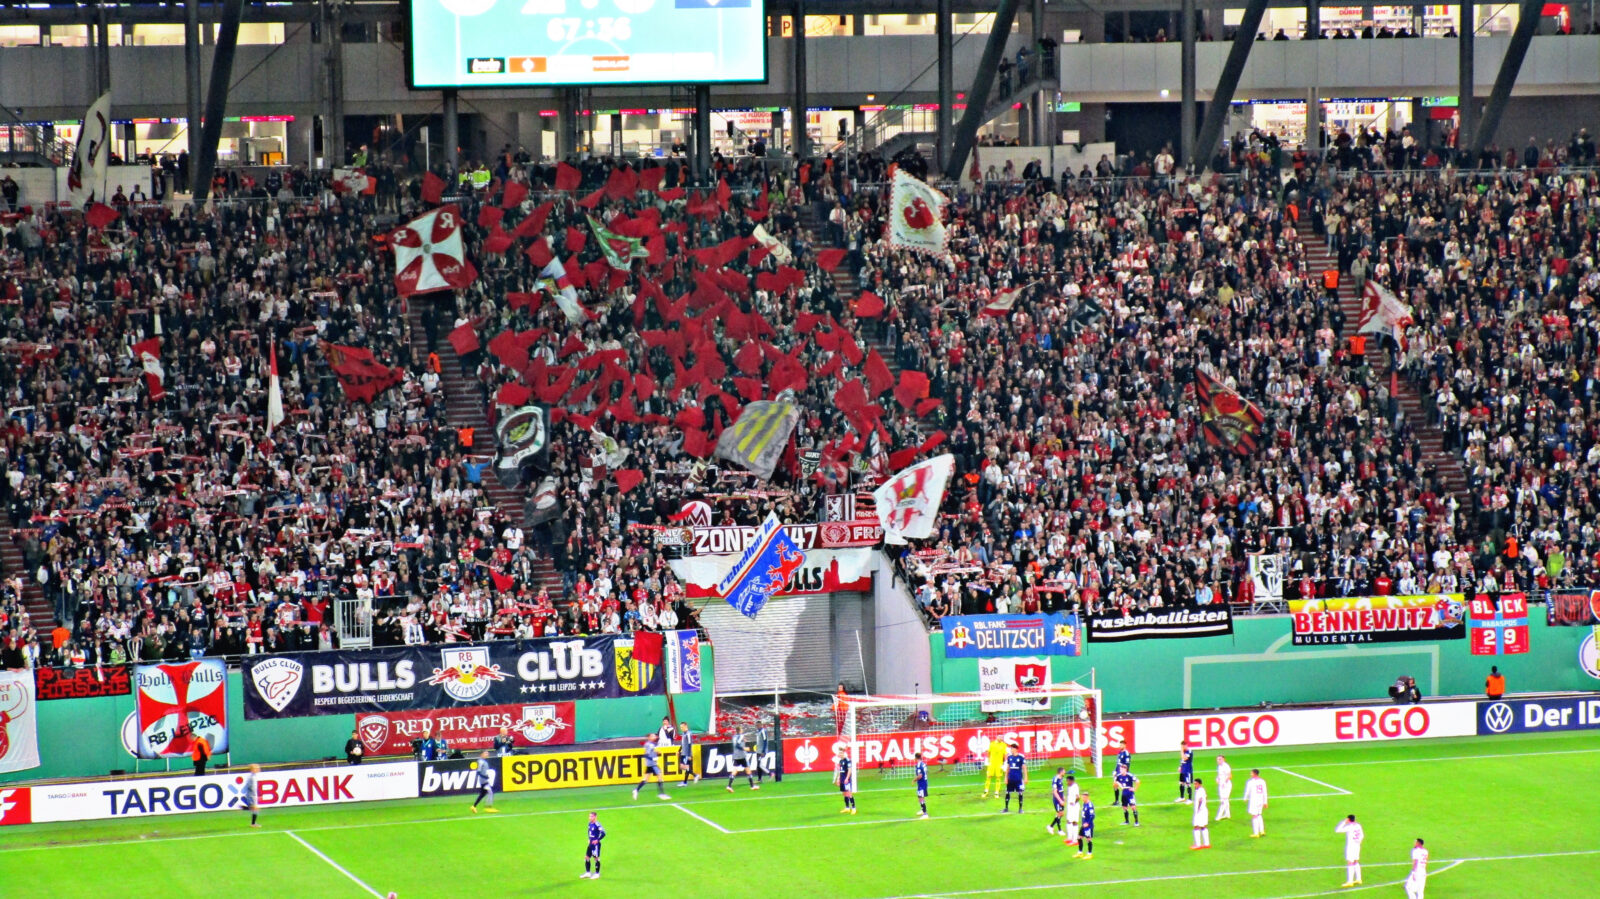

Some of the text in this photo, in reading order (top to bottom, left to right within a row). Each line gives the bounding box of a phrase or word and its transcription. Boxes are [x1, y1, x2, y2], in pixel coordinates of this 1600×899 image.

[973, 620, 1007, 630] RBL FANS
[1092, 609, 1228, 628] rasenballisten
[1293, 607, 1434, 634] BENNEWITZ
[976, 627, 1045, 649] DELITZSCH
[1295, 633, 1374, 644] MULDENTAL
[458, 652, 473, 661] RB
[517, 640, 604, 682] CLUB
[253, 660, 301, 675] BULLS CLUB
[311, 660, 416, 694] BULLS
[38, 681, 130, 698] HIRSCHE
[557, 683, 577, 692] LEIPZIG
[314, 692, 414, 706] RESPEKT BEGEISTERUNG LEIDENSCHAFT
[392, 713, 513, 737] RED PIRATES
[1334, 706, 1430, 741] ERGO
[1524, 703, 1573, 728] Der
[148, 731, 168, 746] RB
[1183, 714, 1279, 748] ERGO
